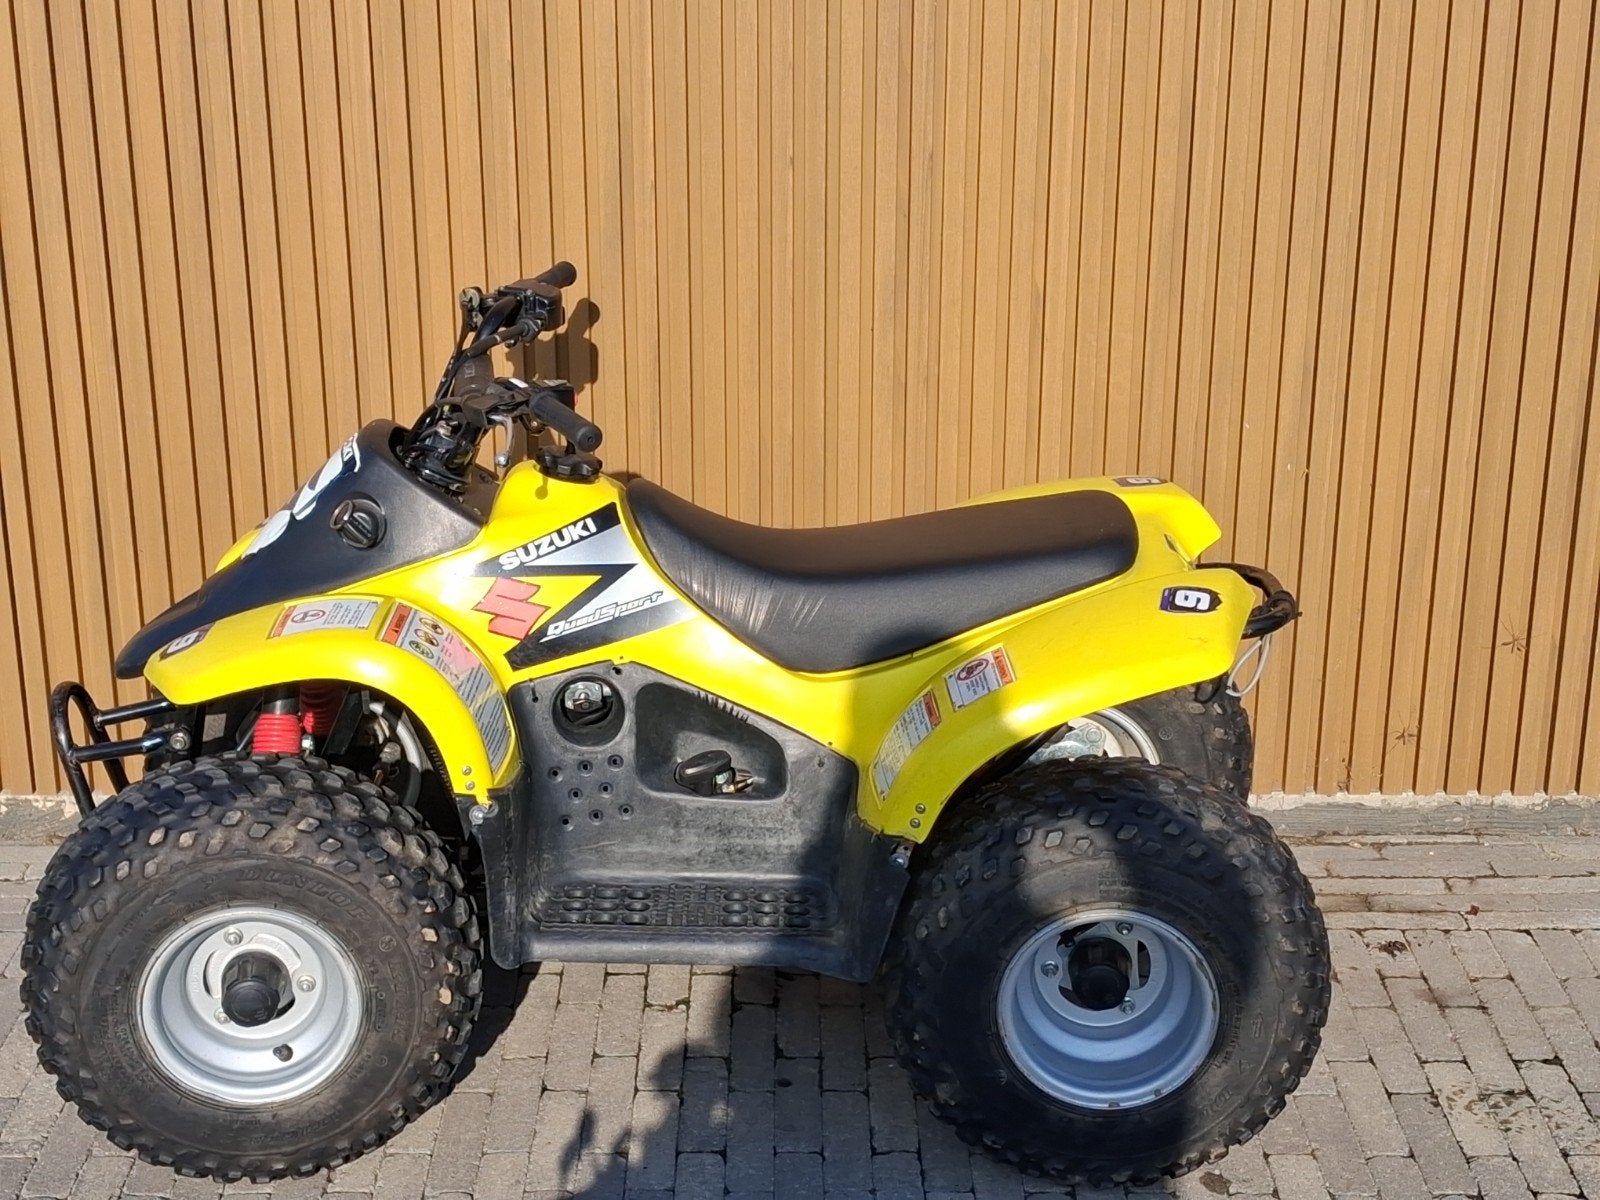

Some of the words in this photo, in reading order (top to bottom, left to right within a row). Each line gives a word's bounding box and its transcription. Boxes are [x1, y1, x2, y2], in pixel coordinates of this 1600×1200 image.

[498, 517, 598, 571] SUZUKI
[546, 590, 664, 637] QuadSport
[234, 868, 372, 922] DUNLOP
